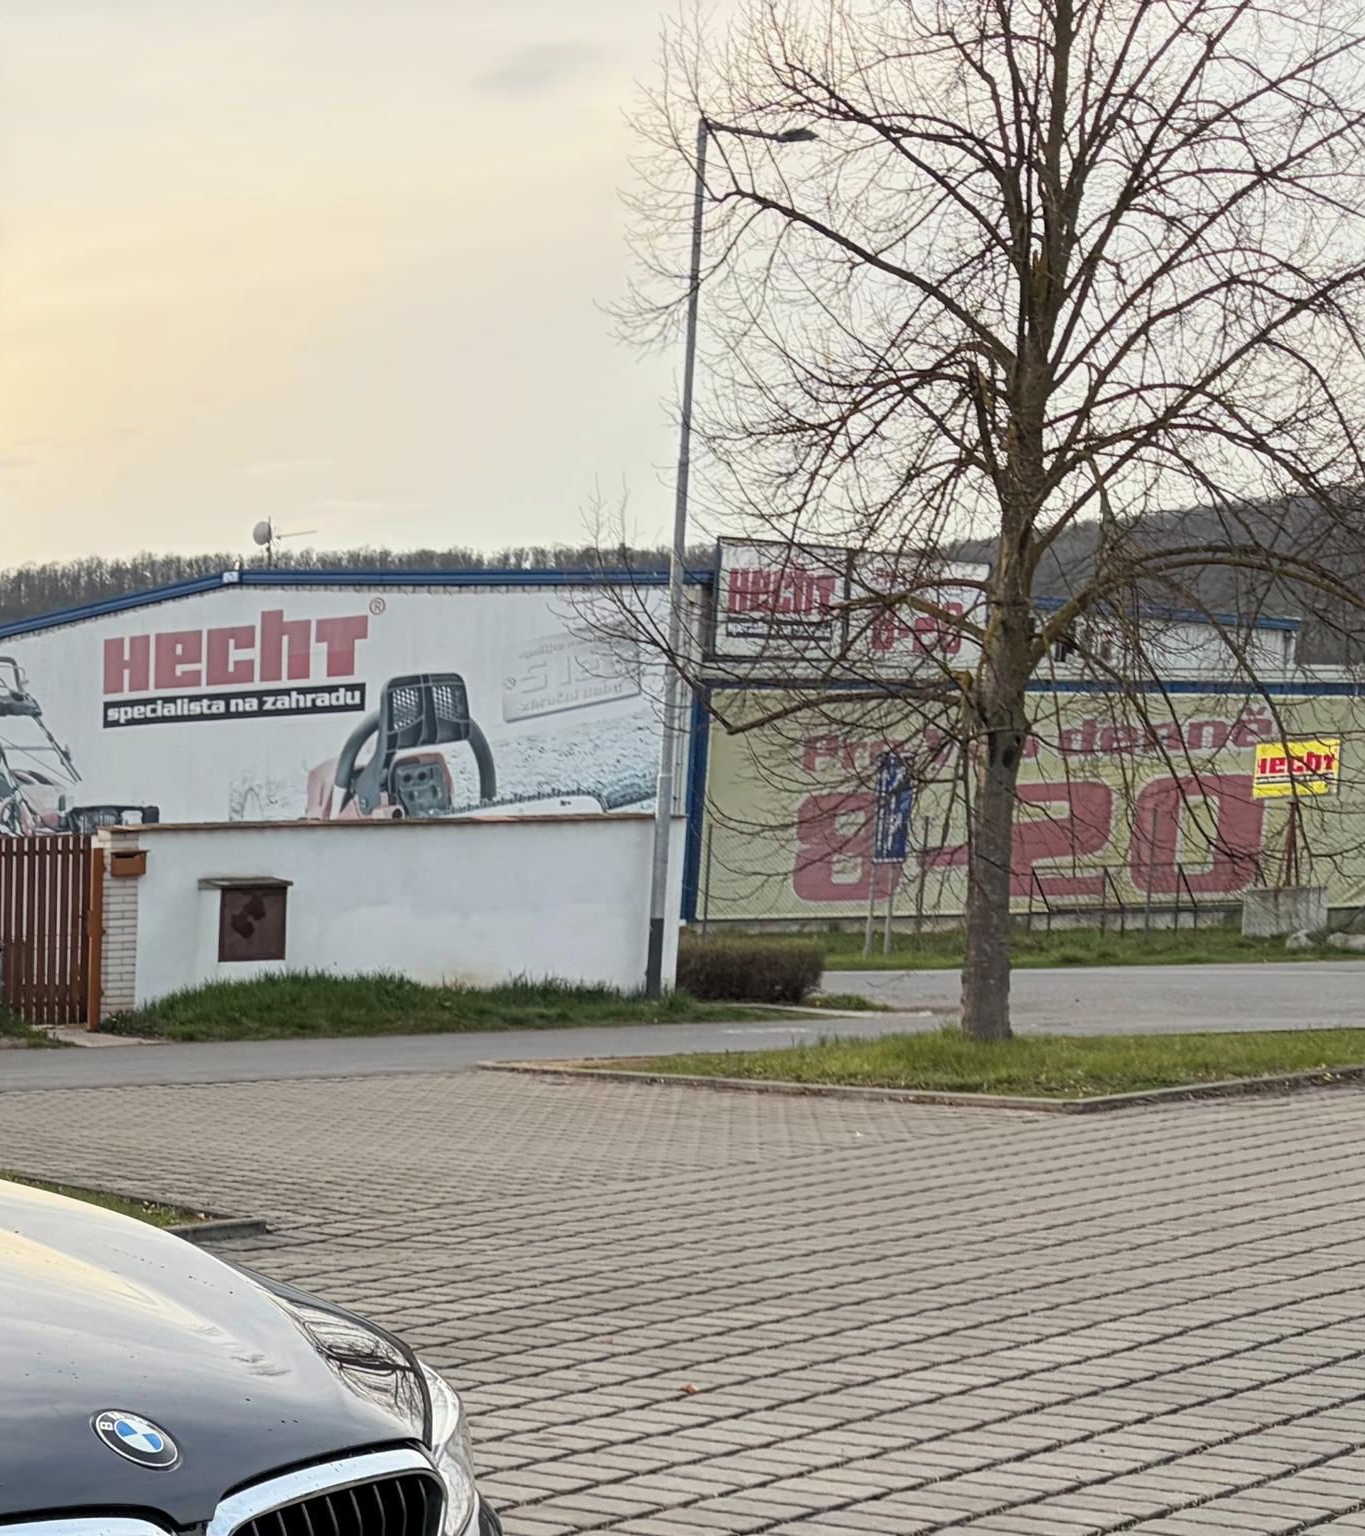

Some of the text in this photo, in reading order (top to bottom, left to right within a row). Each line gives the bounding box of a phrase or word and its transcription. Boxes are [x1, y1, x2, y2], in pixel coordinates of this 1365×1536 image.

[107, 688, 361, 723] specialista na zahradu
